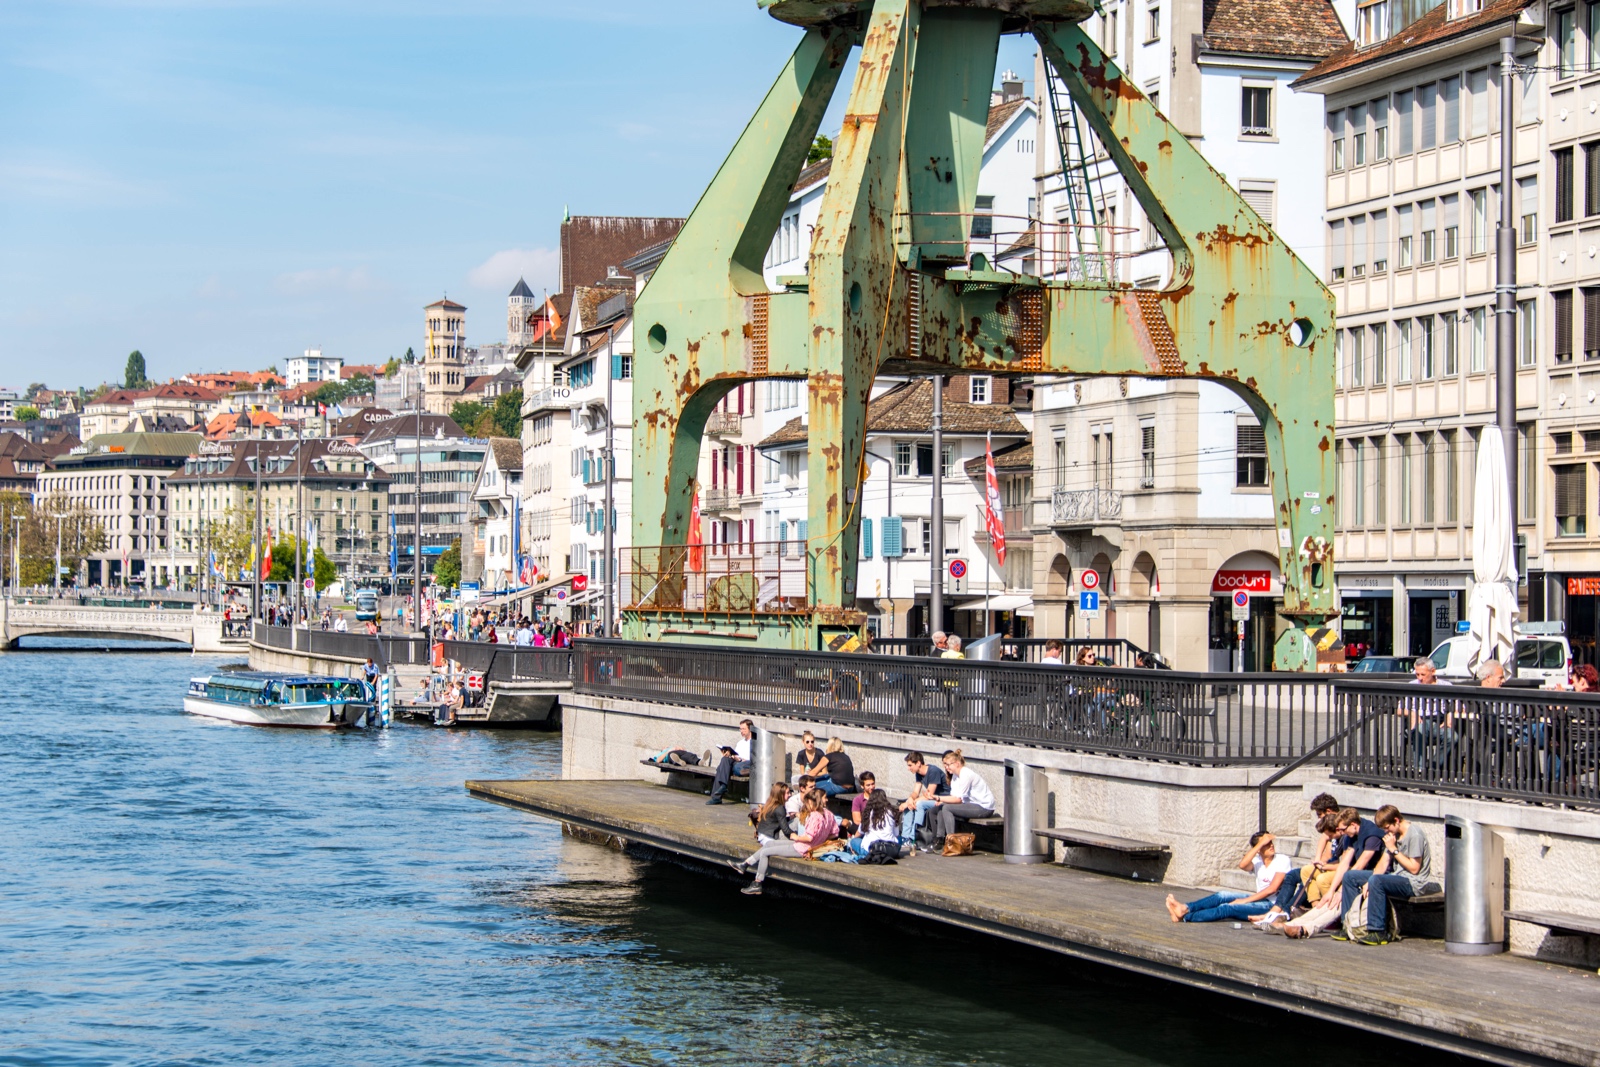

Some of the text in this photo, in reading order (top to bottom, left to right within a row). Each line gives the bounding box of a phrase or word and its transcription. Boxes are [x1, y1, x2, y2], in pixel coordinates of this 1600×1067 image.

[1218, 574, 1266, 587] bodum
[1355, 577, 1379, 587] modissa
[1424, 576, 1449, 587] modissa
[1568, 577, 1600, 595] RAIFFE
